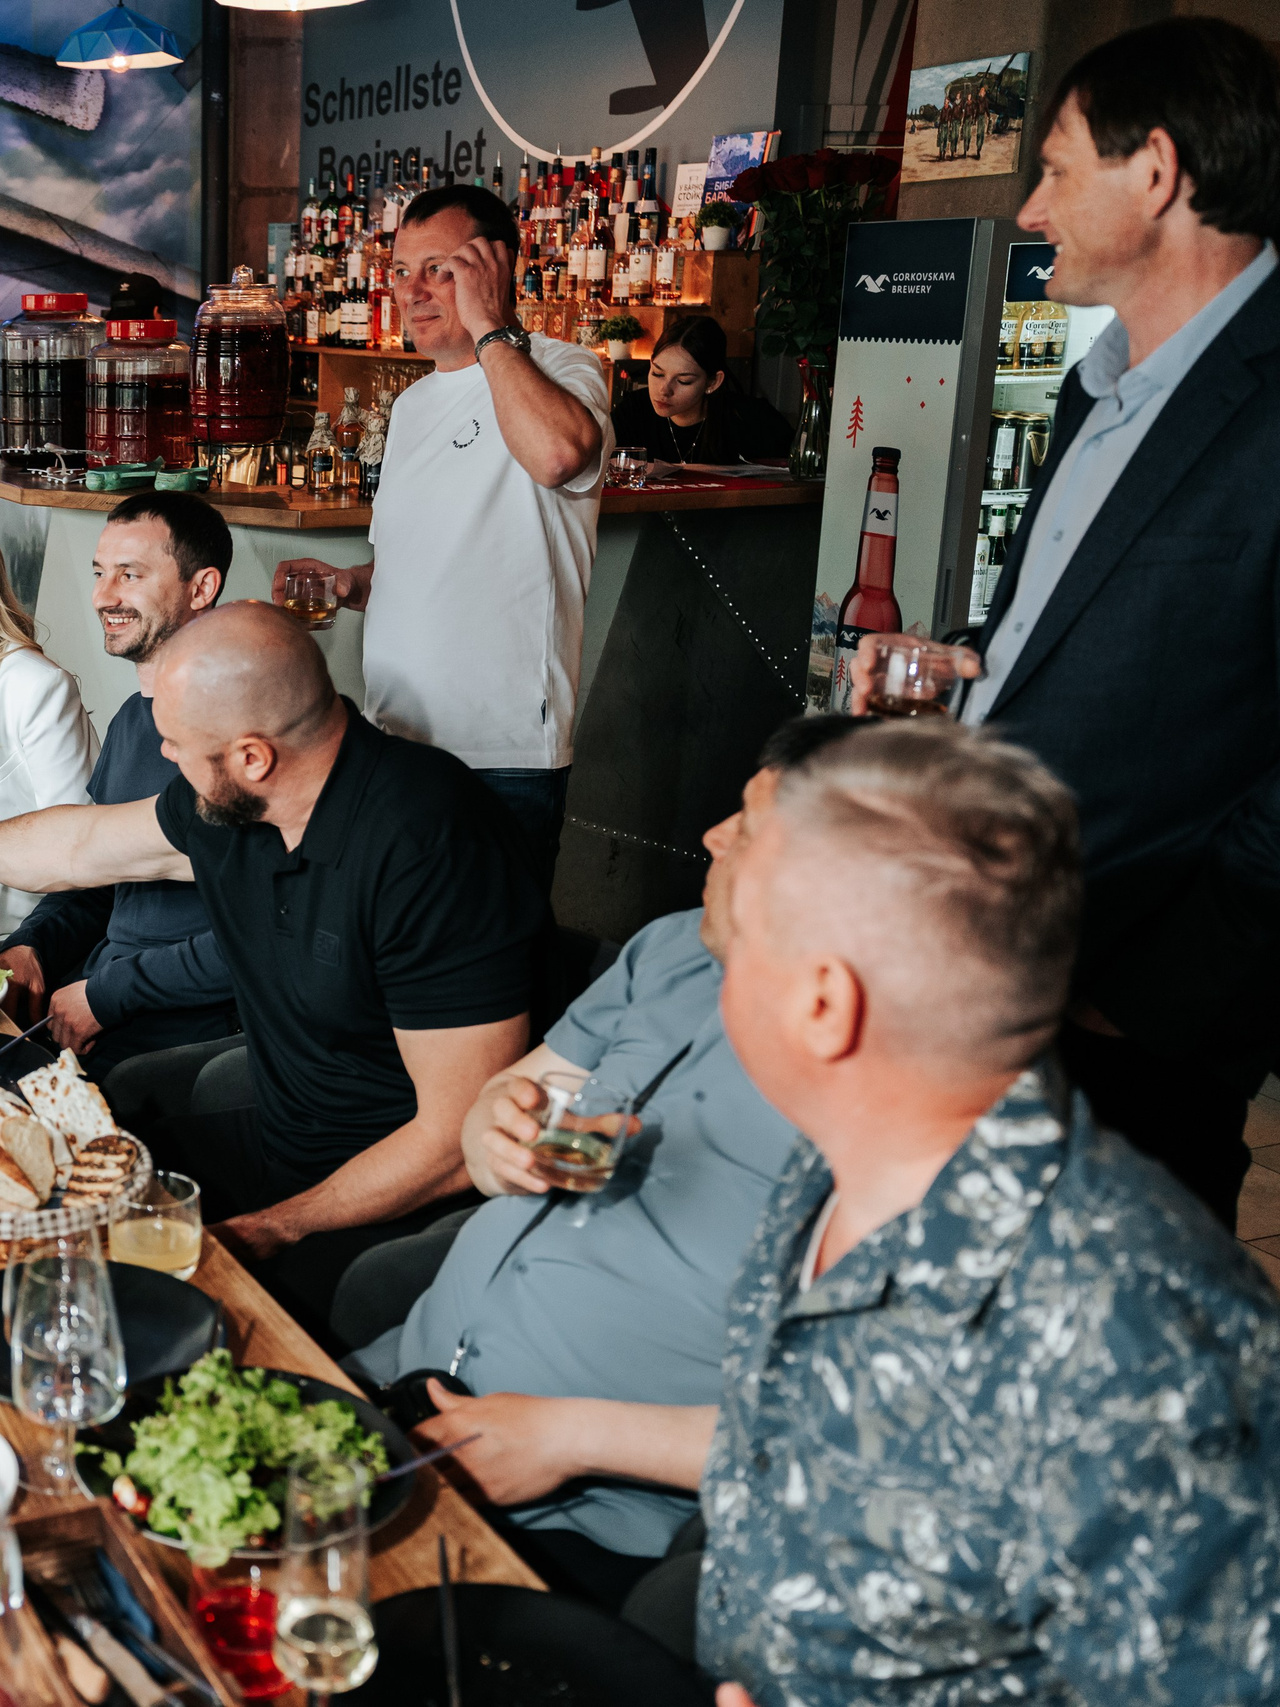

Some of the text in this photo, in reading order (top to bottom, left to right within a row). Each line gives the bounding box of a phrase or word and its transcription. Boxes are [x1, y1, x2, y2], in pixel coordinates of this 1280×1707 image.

[304, 60, 462, 127] Schnellste
[318, 128, 486, 190] Boeing-Jet
[684, 183, 704, 191] БАРНО
[677, 190, 701, 201] СТОЙК
[705, 191, 742, 205] БАРМ
[892, 272, 956, 281] GORKOVSKAYA
[891, 285, 932, 294] BREWERY
